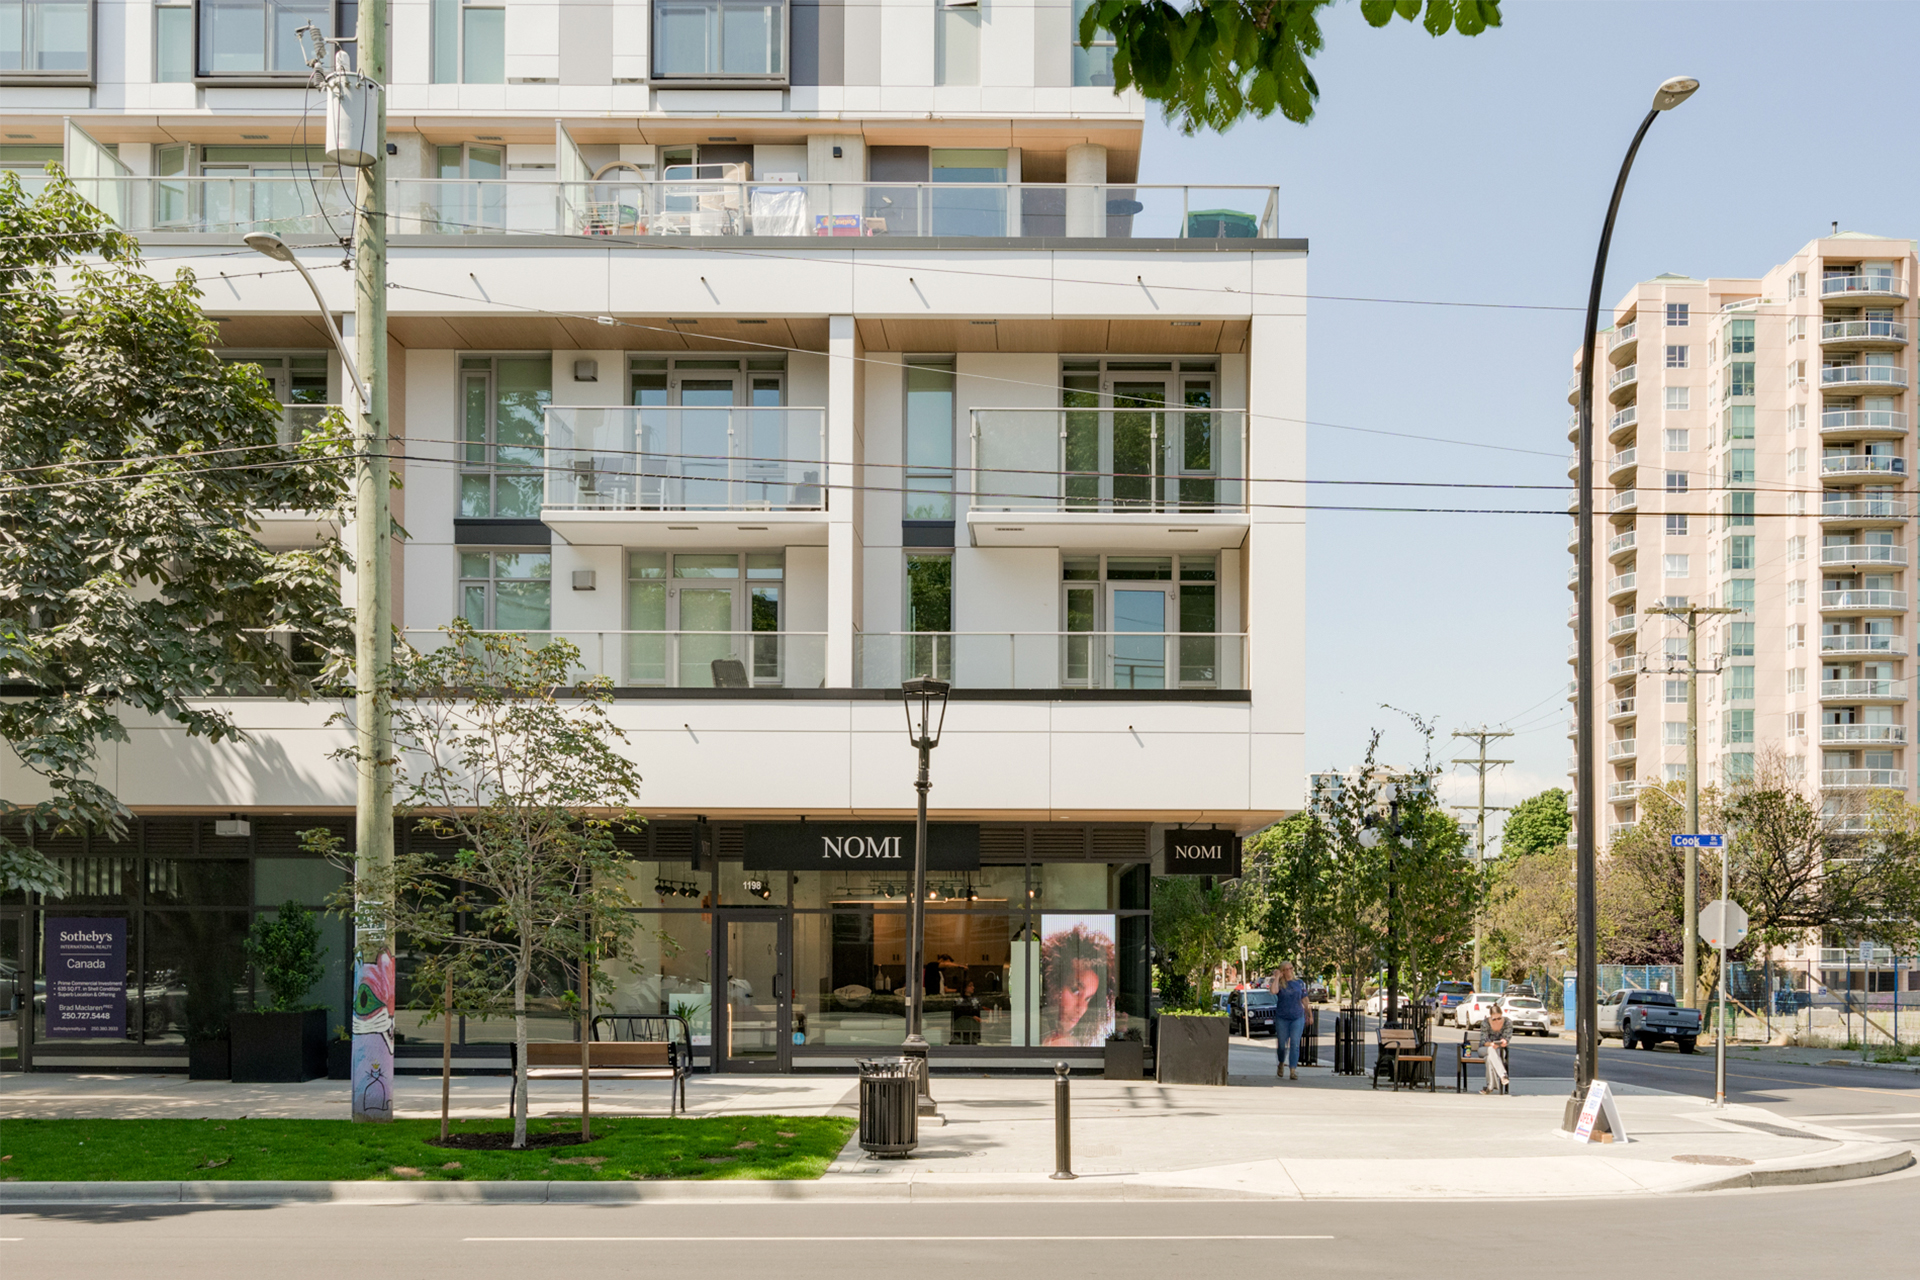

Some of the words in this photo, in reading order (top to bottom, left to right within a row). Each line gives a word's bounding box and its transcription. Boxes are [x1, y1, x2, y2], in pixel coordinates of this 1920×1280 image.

[1674, 835, 1700, 847] Cook
[821, 836, 902, 859] NOMI
[1174, 845, 1222, 859] NOMI
[743, 881, 762, 890] 1198
[60, 930, 113, 944] Sotheby's
[67, 958, 106, 969] Canada
[61, 1012, 110, 1020] 250.727.5448
